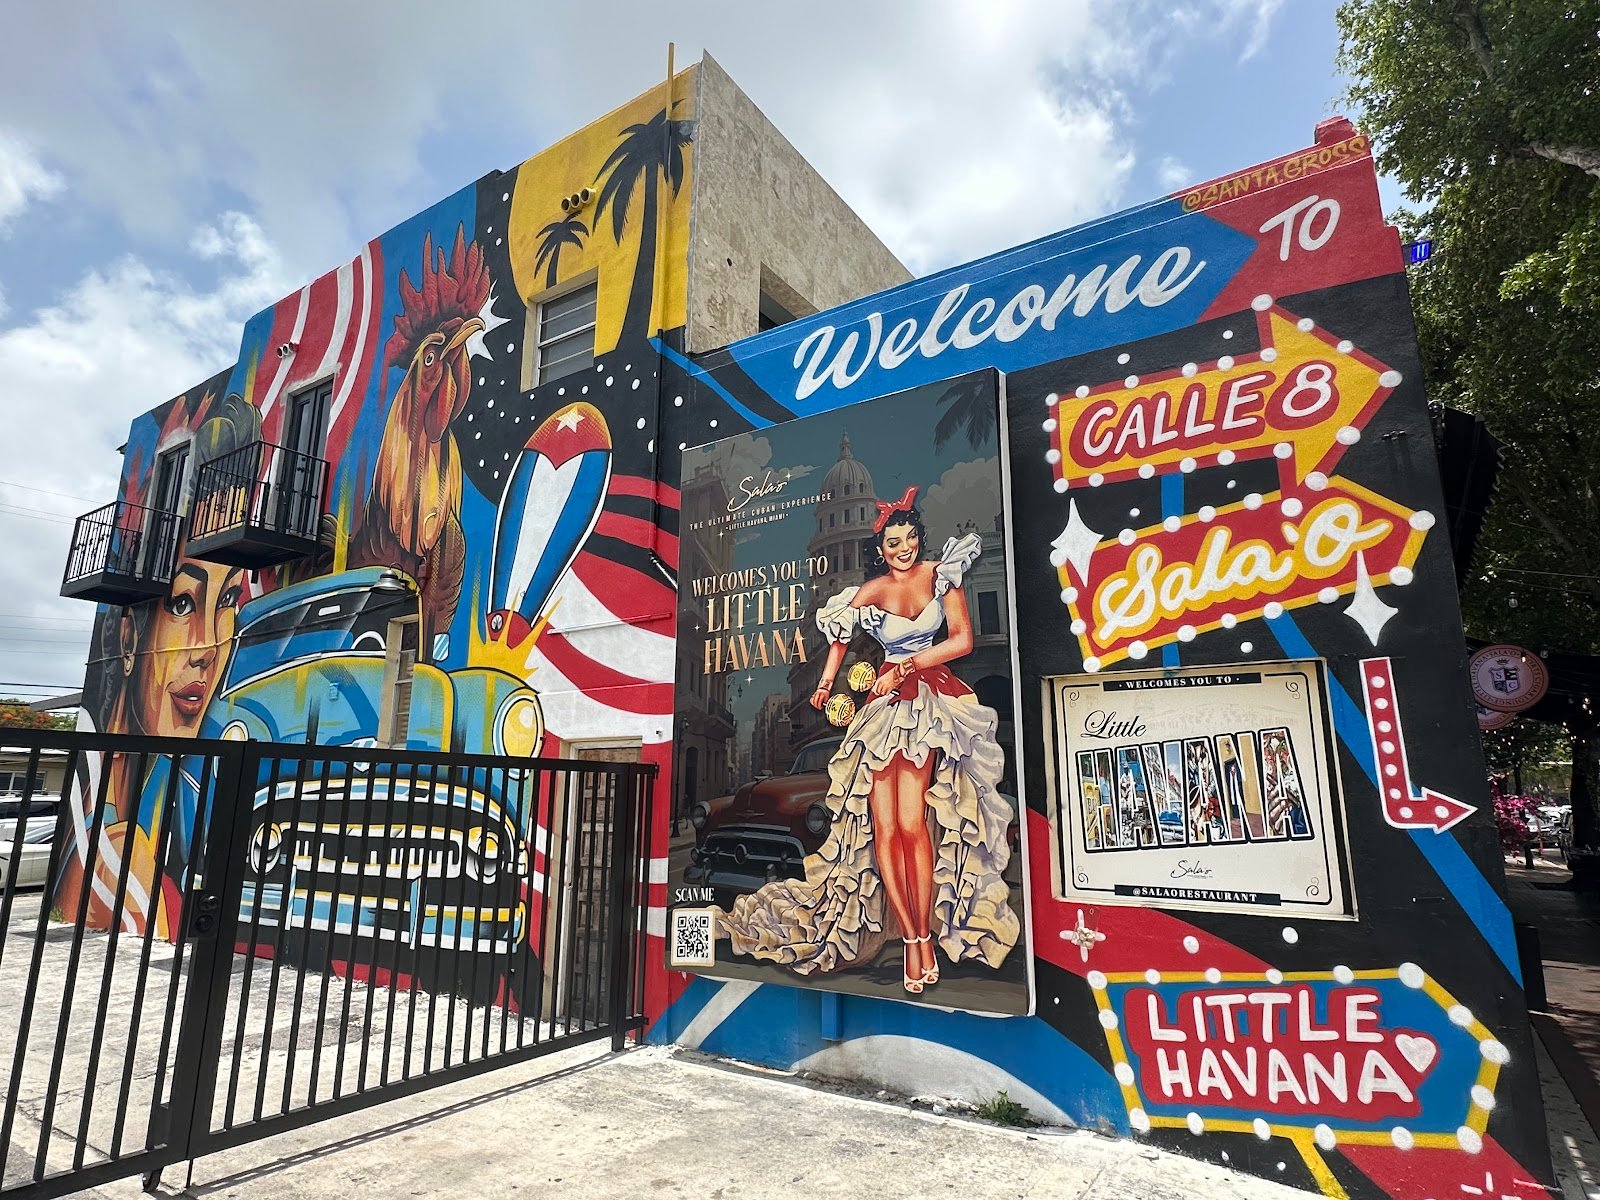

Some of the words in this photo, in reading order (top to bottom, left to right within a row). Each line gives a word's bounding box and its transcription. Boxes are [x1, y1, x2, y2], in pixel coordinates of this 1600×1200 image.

[793, 246, 1207, 401] Welcome
[1259, 194, 1341, 262] TO
[1082, 373, 1268, 459] CALLE
[1281, 363, 1333, 418] 8
[690, 521, 704, 531] THE
[708, 511, 746, 527] ULTIMATE
[751, 505, 776, 517] CUBAN
[781, 492, 832, 510] EXPERIENCE
[728, 521, 746, 531] LITTLE
[768, 513, 785, 523] MIAMI
[692, 566, 767, 598] WELCOMES
[771, 559, 802, 584] YOU
[806, 555, 829, 578] TO
[707, 583, 806, 633] LITTLE
[703, 626, 808, 675] HAVANA
[1125, 678, 1187, 690] WELCOMES
[1190, 676, 1213, 685] YOU
[1216, 675, 1232, 684] TO
[1080, 709, 1147, 740] Little
[1075, 727, 1315, 853] HAVANA
[675, 887, 698, 902] SCAN
[700, 887, 715, 902] ME
[1132, 886, 1258, 903] @SALAORESTAURANT
[1147, 989, 1384, 1044] LITTLE
[1156, 1046, 1414, 1105] HAVANA
